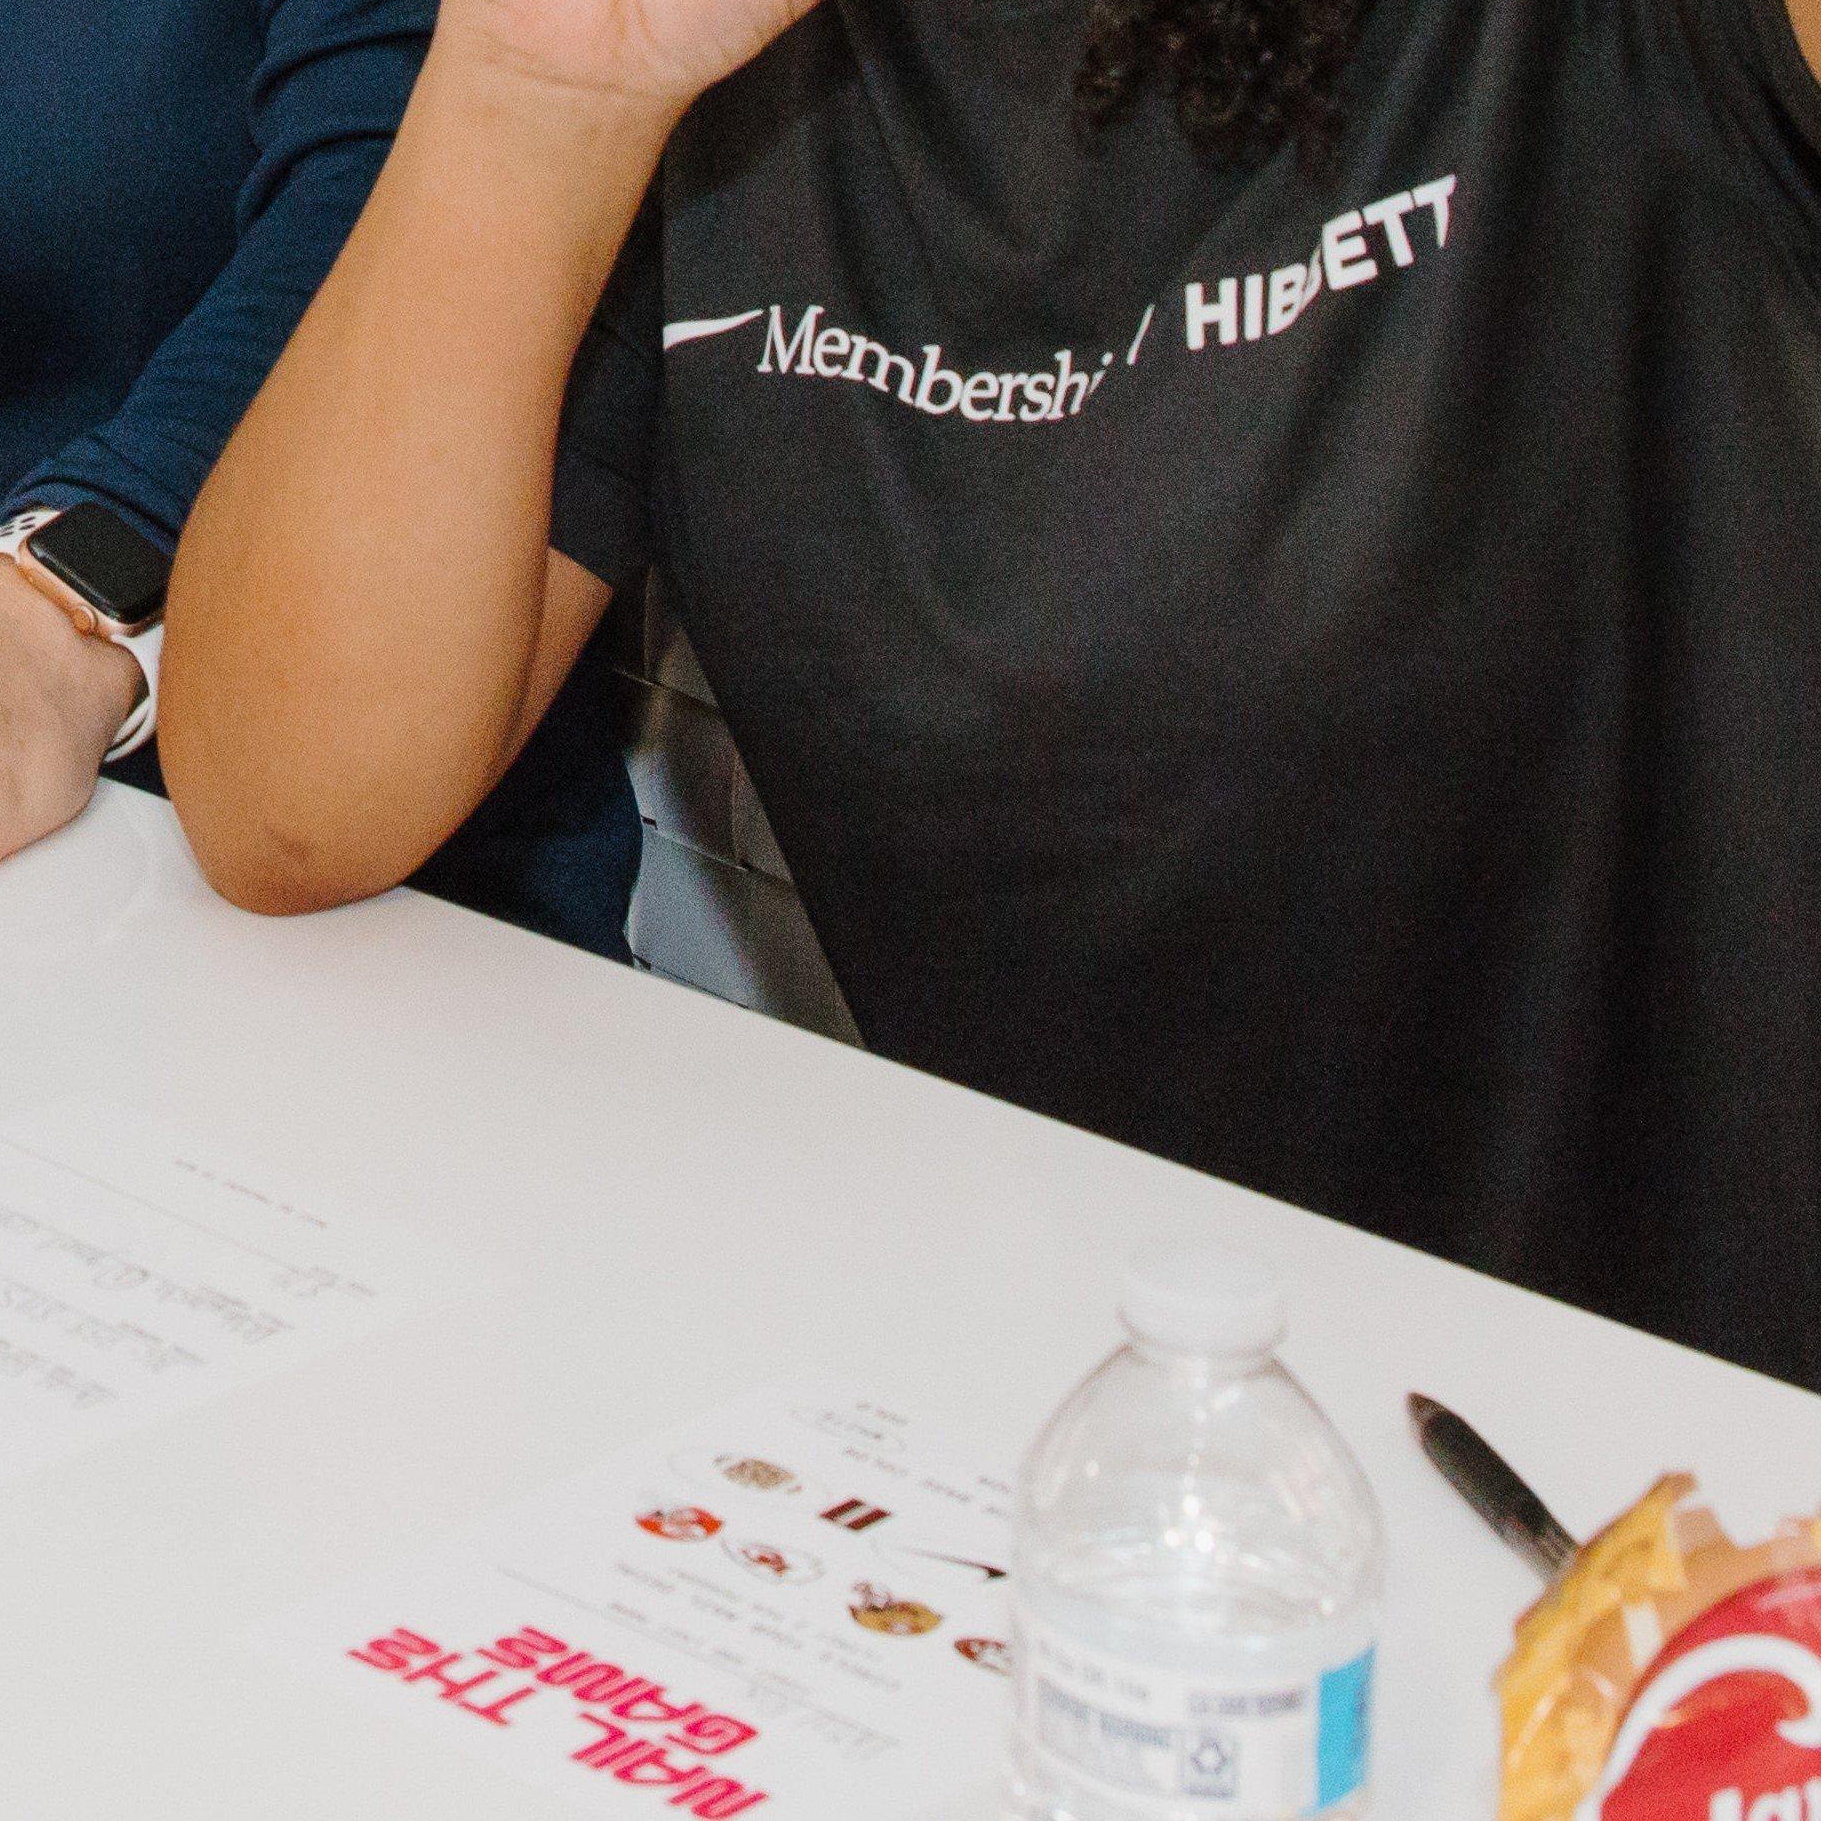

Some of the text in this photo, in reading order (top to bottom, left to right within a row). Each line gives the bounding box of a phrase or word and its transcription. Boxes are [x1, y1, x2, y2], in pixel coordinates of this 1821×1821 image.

[756, 304, 1114, 423] Membershi
[346, 1626, 540, 1728] THE
[474, 1625, 761, 1758] GAME
[568, 1710, 770, 1821] NAIL
